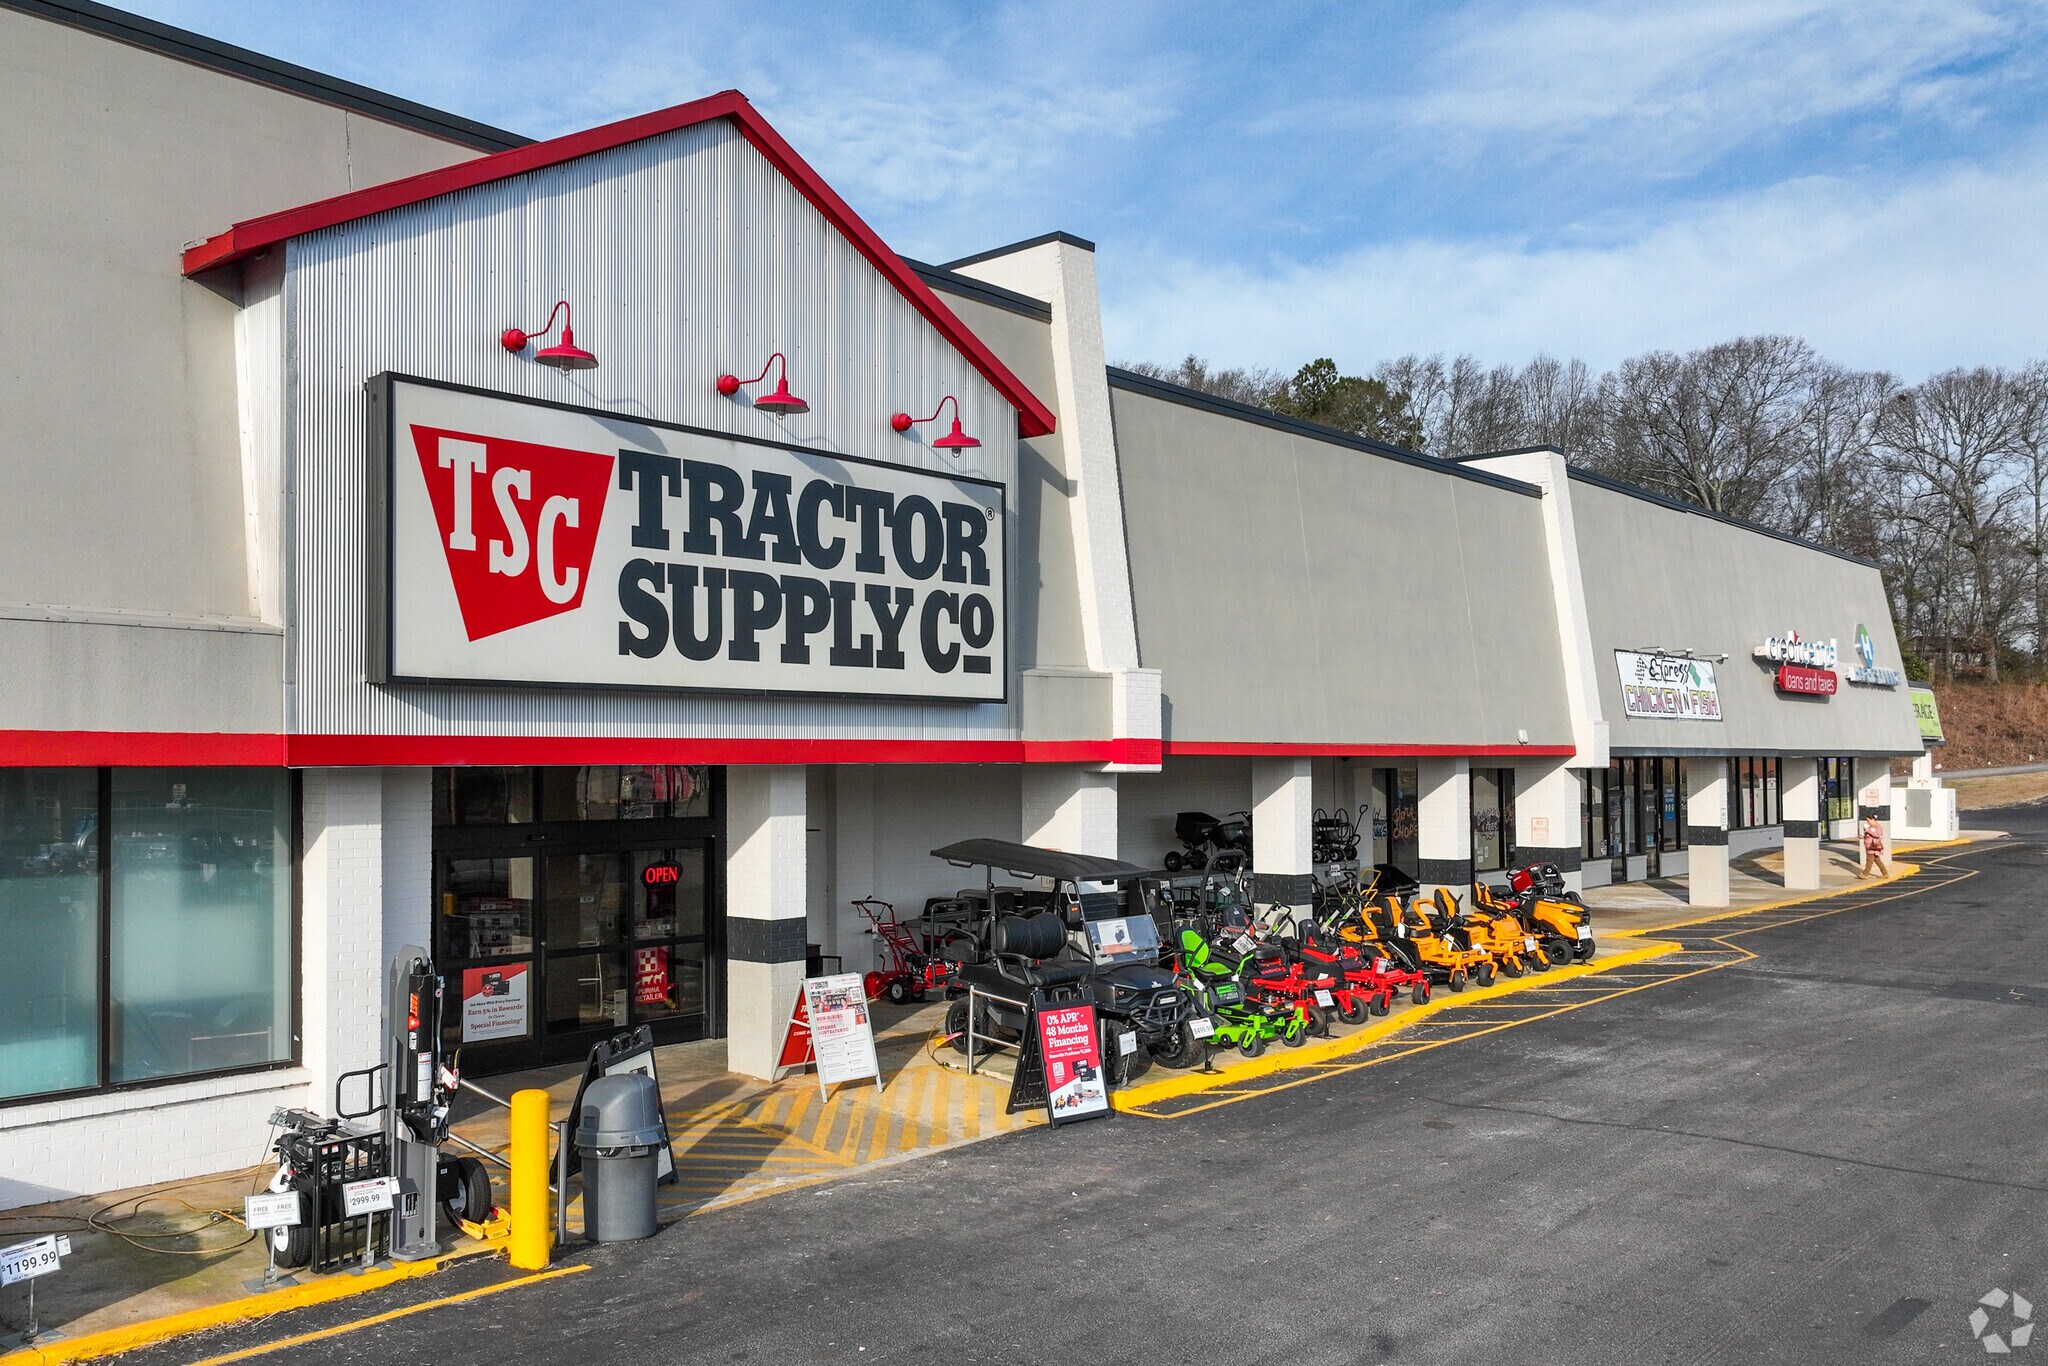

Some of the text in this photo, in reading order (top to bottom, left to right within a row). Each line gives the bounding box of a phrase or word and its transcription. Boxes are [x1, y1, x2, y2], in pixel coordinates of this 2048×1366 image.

[438, 437, 579, 603] TSC
[619, 449, 990, 586] TRACTOR
[619, 559, 912, 669] SUPPLY
[1785, 669, 1804, 690] loans
[1805, 673, 1817, 691] and
[1818, 674, 1834, 692] taxes
[1624, 684, 1684, 714] CHICKEN
[1689, 689, 1719, 716] FISH
[646, 867, 678, 883] OPEN
[638, 986, 660, 994] PURINA
[471, 1022, 491, 1030] Special
[1047, 1014, 1059, 1025] 0%
[1046, 1023, 1088, 1036] 48 Months
[1048, 1034, 1089, 1048] Financing
[1, 1251, 56, 1275] $1199.99
